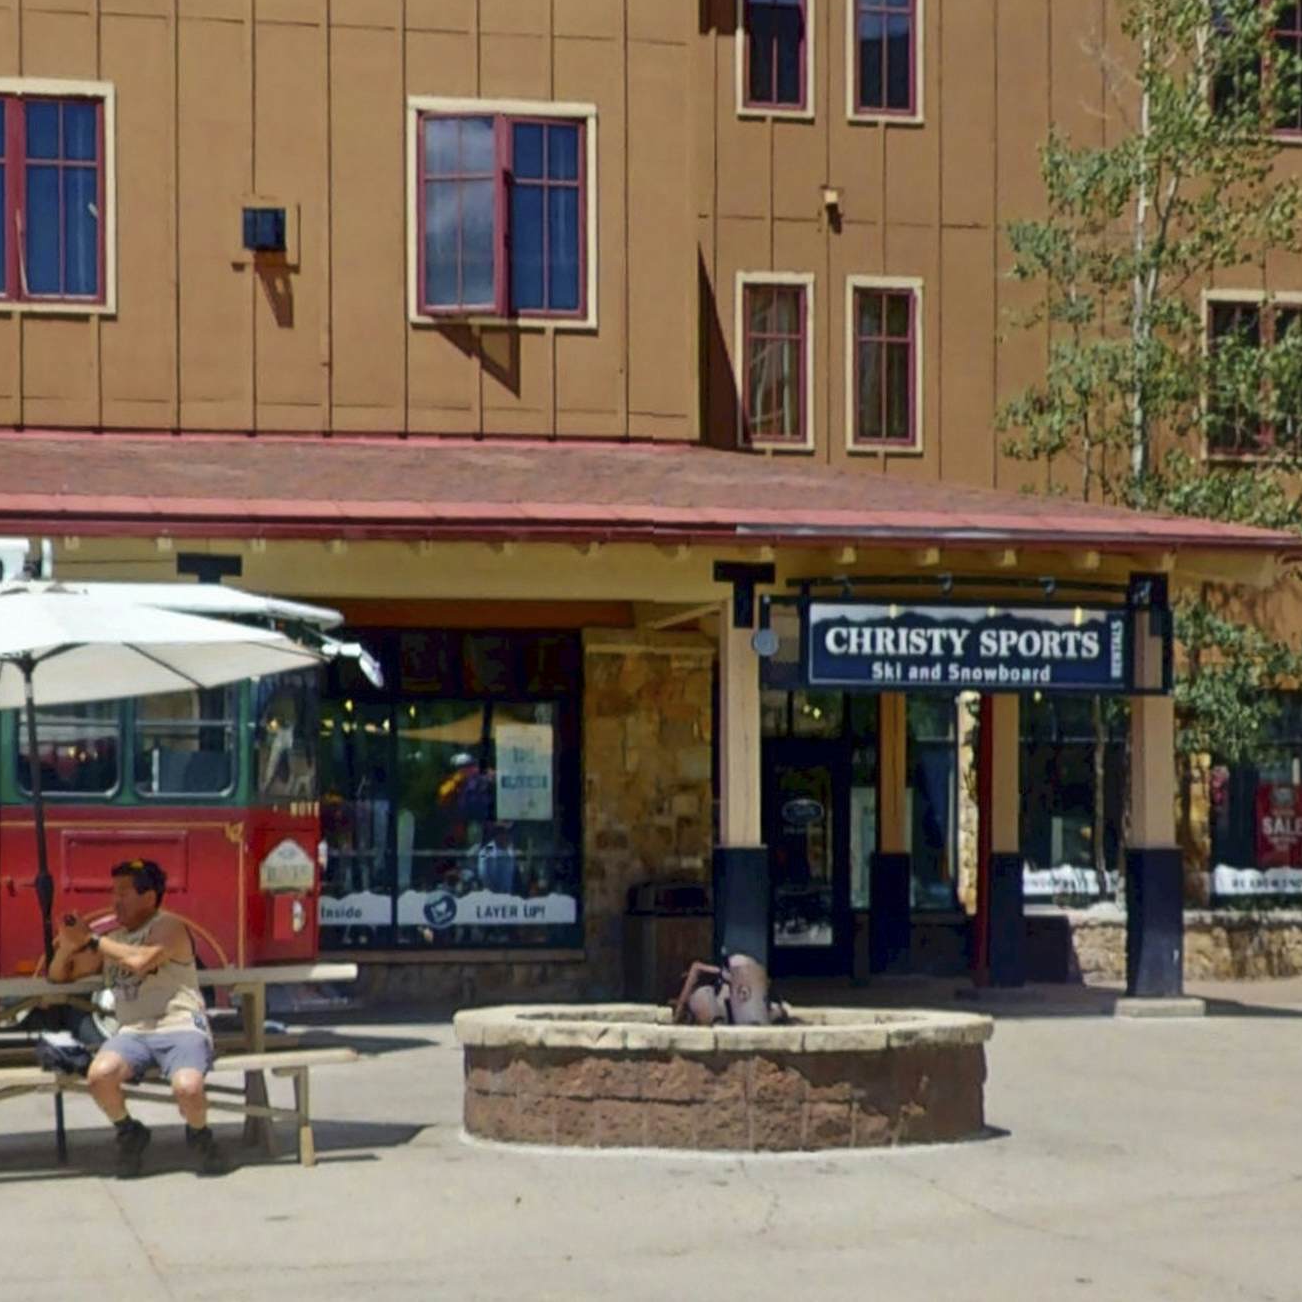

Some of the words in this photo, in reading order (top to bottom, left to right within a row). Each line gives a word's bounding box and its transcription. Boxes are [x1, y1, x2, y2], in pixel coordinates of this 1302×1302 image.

[825, 626, 970, 655] CHRISTY
[979, 629, 1100, 658] SPORTS
[1110, 620, 1124, 678] RENTALS
[871, 662, 901, 680] Ski
[908, 663, 941, 681] and
[948, 663, 1051, 682] Snowboard
[476, 905, 518, 920] LAYER
[523, 904, 546, 919] UP!
